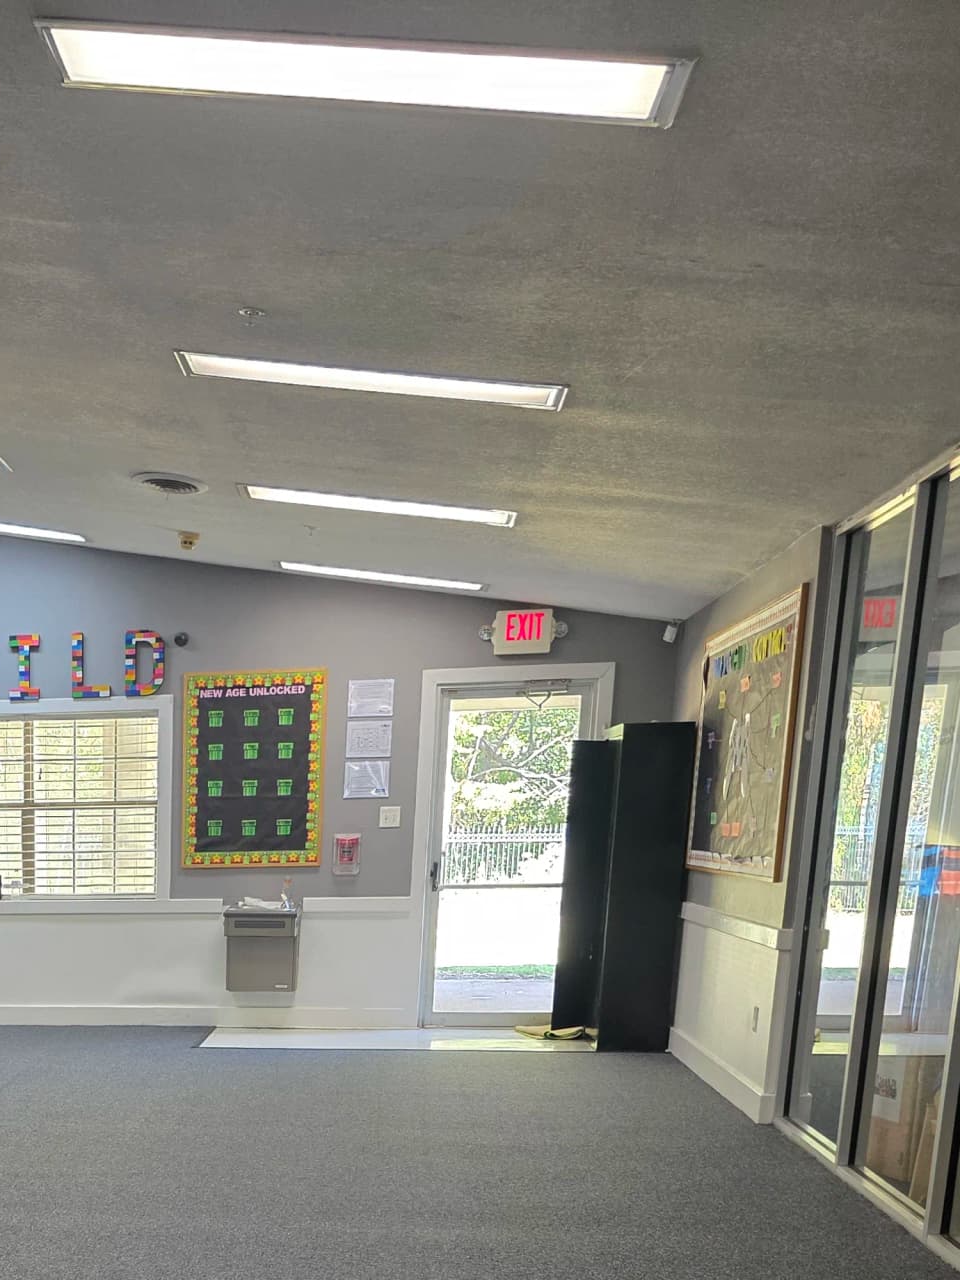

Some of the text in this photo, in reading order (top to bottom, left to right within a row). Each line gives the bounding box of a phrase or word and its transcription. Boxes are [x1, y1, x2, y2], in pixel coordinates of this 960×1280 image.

[506, 612, 545, 641] EXIT
[200, 685, 306, 699] NEW AGE UNLOCKED
